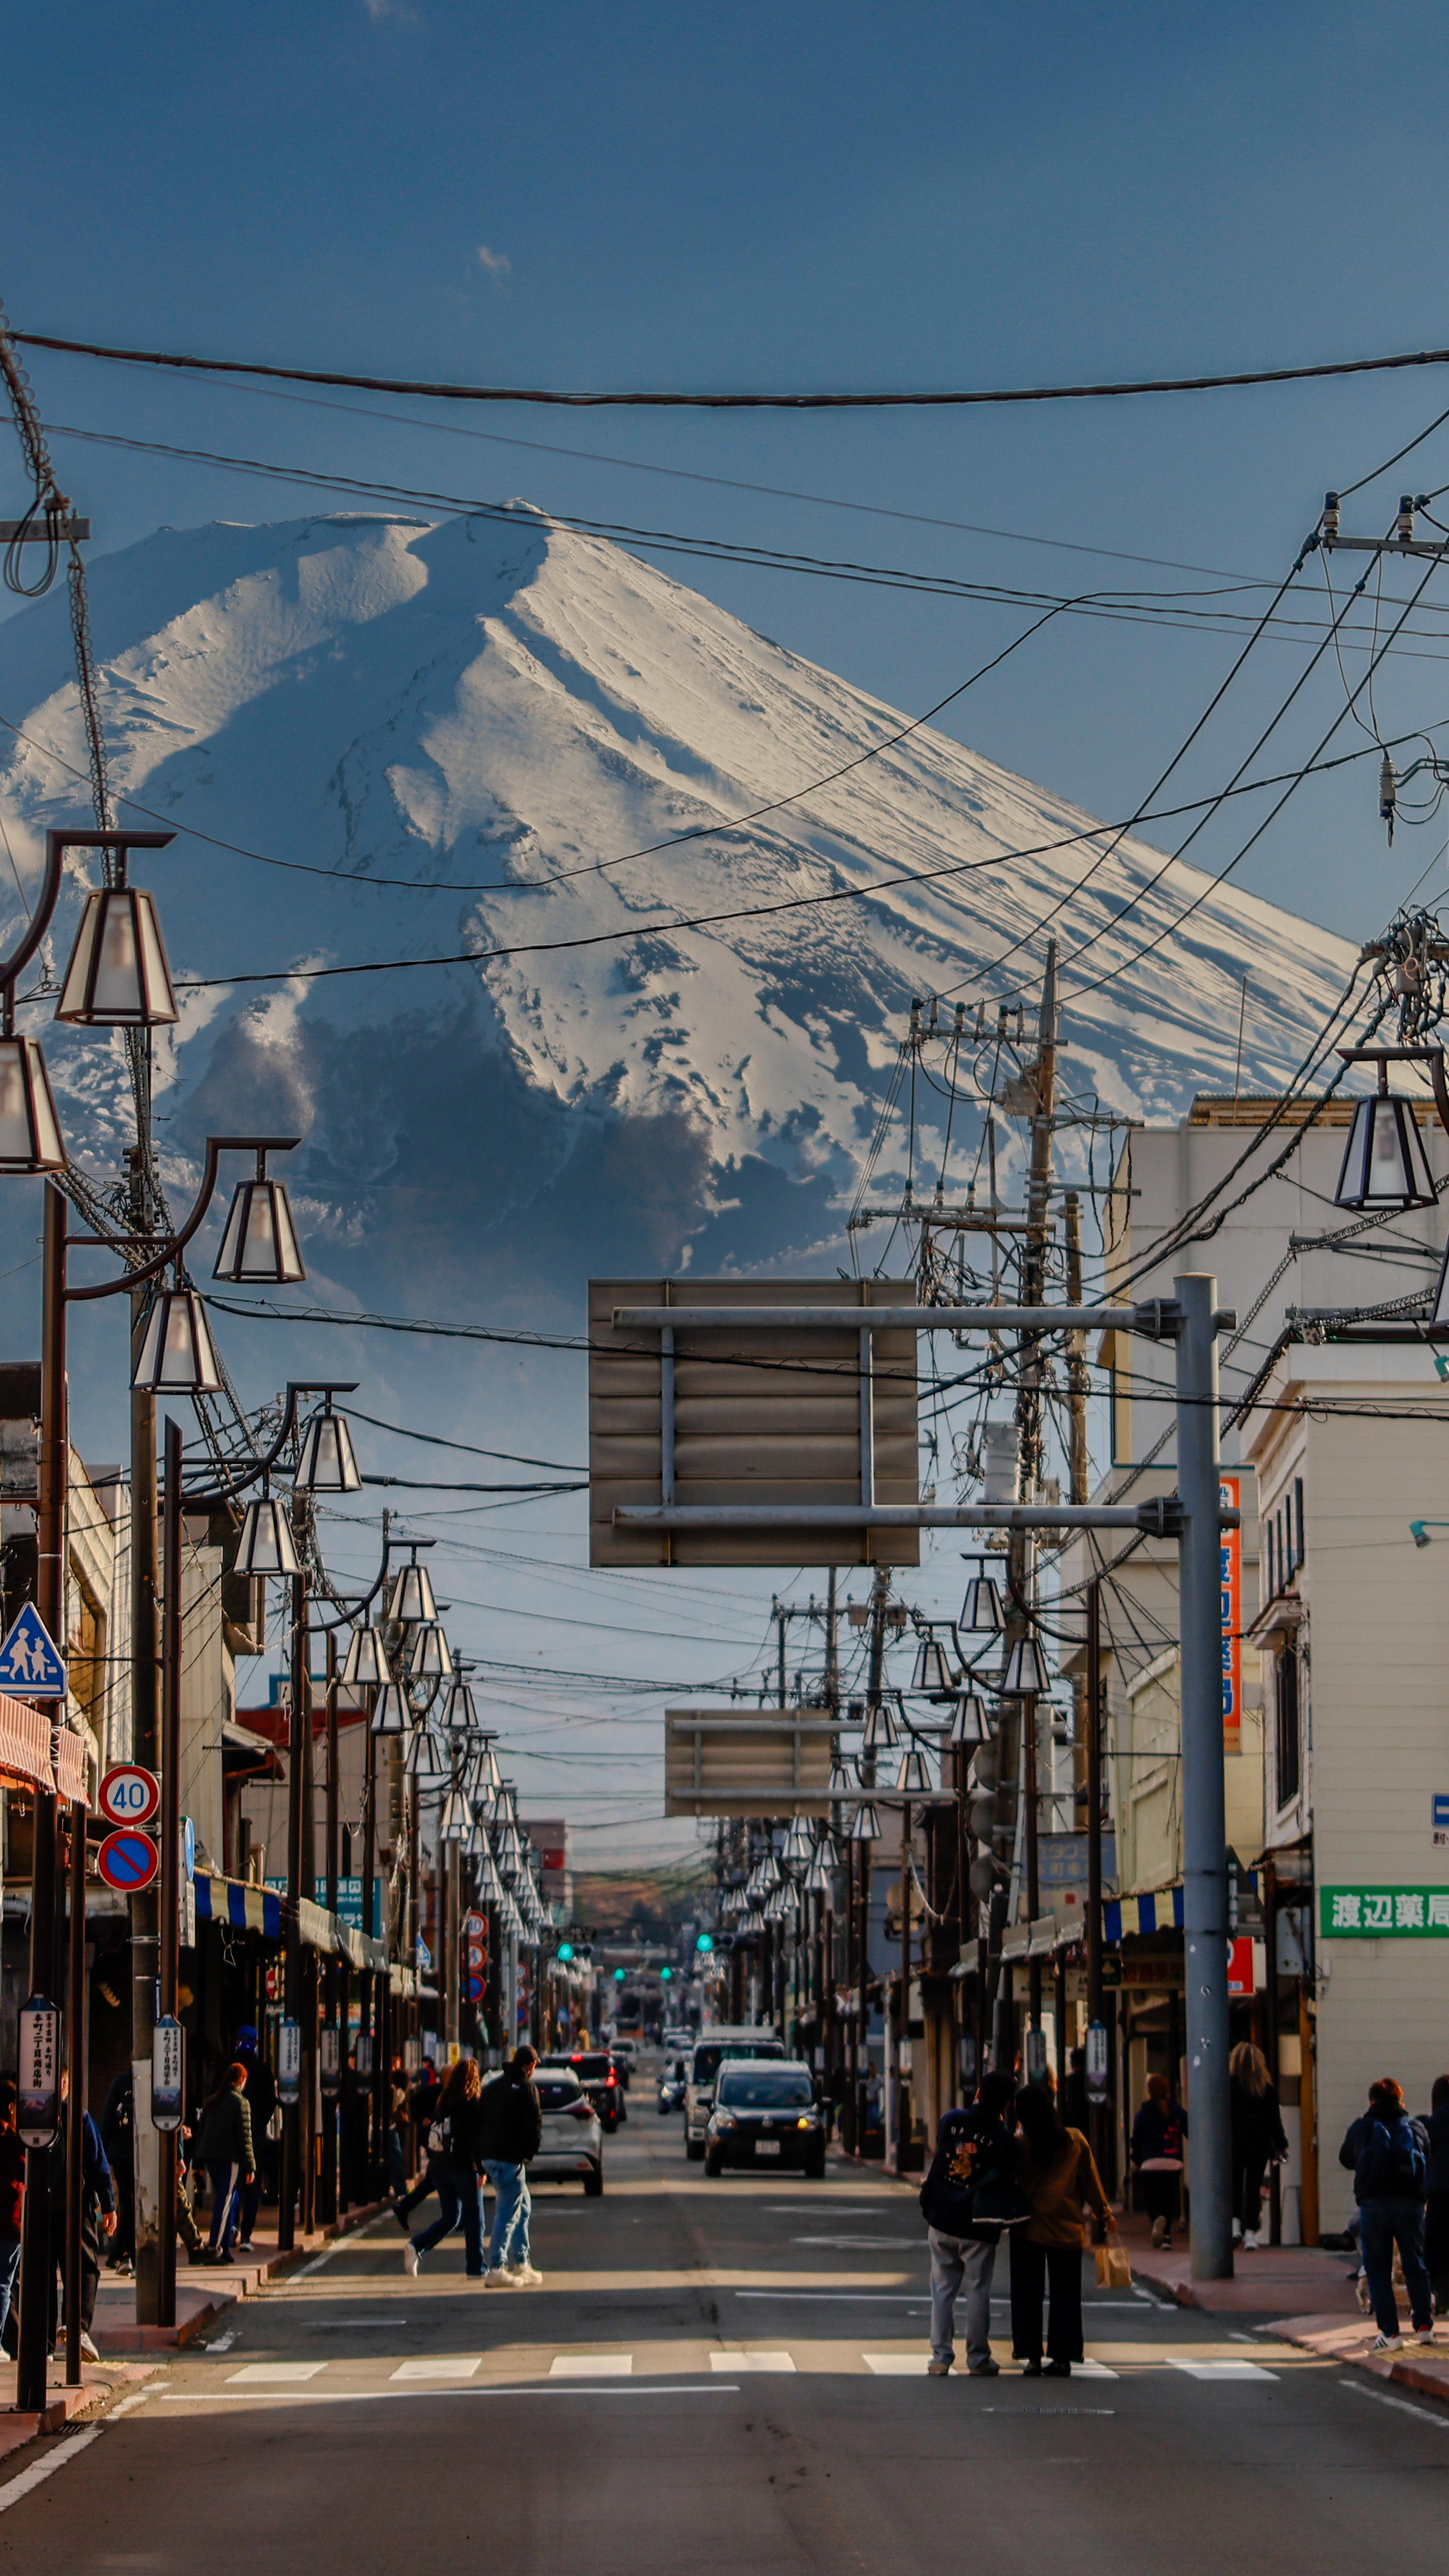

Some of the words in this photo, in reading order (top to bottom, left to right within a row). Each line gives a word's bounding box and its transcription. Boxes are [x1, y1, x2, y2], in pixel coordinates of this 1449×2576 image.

[112, 1782, 145, 1809] 40
[1332, 1894, 1449, 1928] 渡辺薬局
[32, 2012, 43, 2088] 本町二丁目商店街
